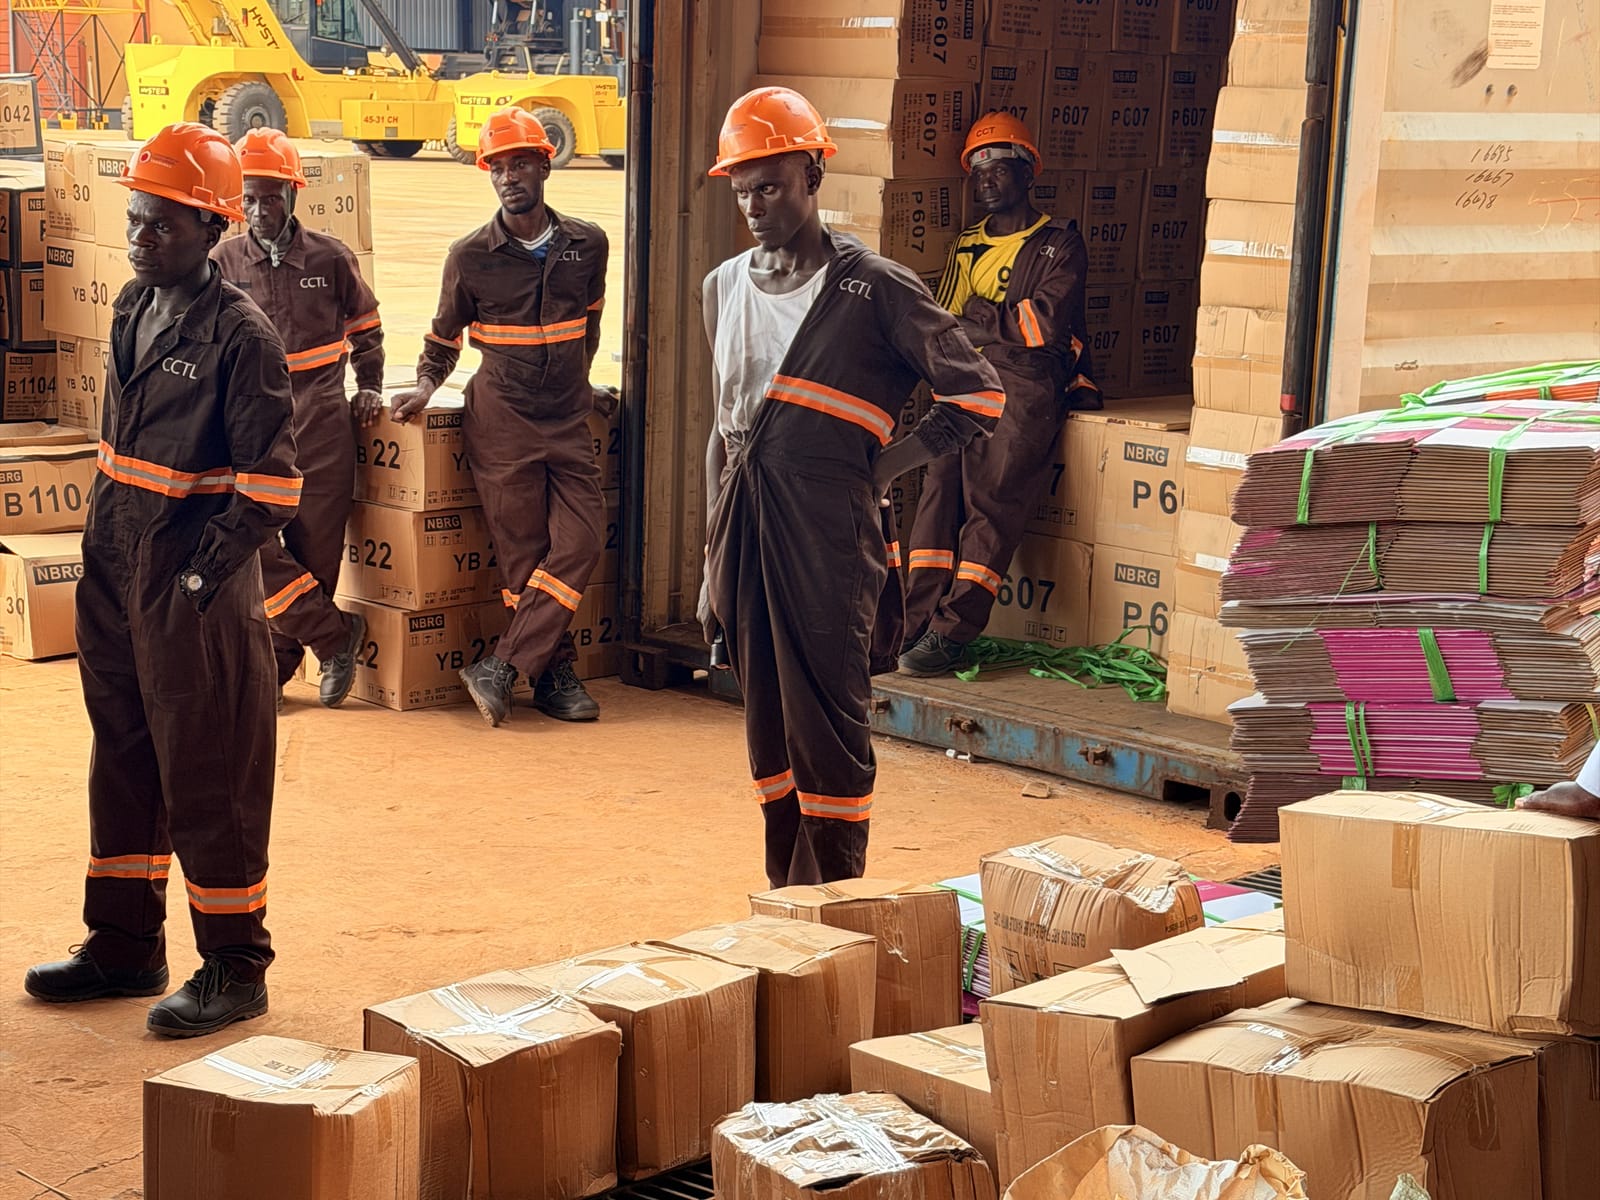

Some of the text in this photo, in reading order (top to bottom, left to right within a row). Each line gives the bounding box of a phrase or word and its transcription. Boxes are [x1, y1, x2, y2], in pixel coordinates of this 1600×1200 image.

[0, 104, 31, 122] 042
[363, 116, 399, 124] 45-31 CH
[1051, 104, 1090, 126] P607
[1171, 106, 1208, 127] P607
[922, 93, 937, 158] P607
[73, 183, 90, 202] 30
[309, 195, 354, 215] YB 30
[911, 190, 926, 254] P607
[1089, 223, 1128, 243] P607
[47, 248, 73, 265] NBRG
[299, 277, 328, 289] CCTL
[839, 277, 872, 300] CCTL
[72, 281, 108, 306] YB 30
[1142, 325, 1181, 345] P607
[162, 356, 198, 380] CCTL
[81, 374, 96, 393] 30
[429, 415, 461, 427] NBRG
[373, 438, 401, 470] 22
[1124, 443, 1166, 464] NBRG
[1133, 479, 1184, 514] P6
[426, 516, 461, 530] NBRG
[364, 538, 393, 571] 22
[453, 551, 481, 573] YB
[36, 565, 84, 582] NBRG
[1116, 566, 1159, 586] NBRG
[411, 615, 444, 630] NBRG
[436, 650, 465, 672] YB
